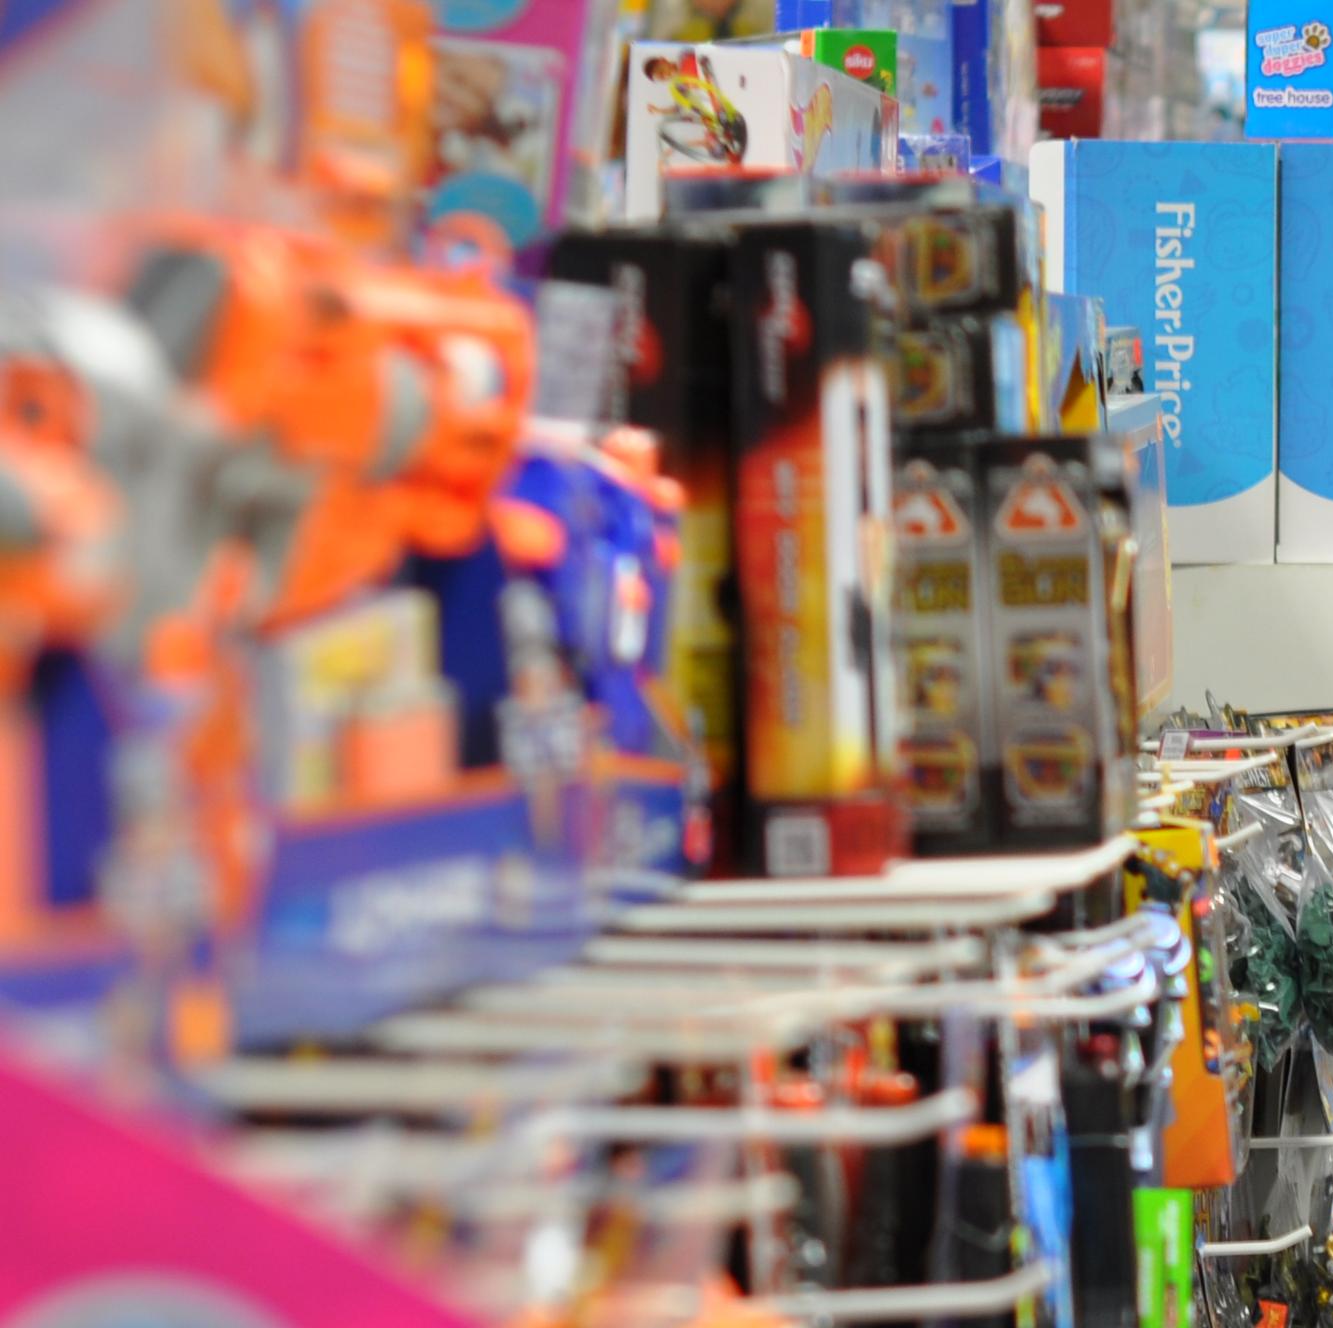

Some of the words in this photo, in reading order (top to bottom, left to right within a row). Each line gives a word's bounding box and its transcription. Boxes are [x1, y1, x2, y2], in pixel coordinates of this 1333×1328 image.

[1263, 51, 1323, 75] doggies
[1256, 90, 1284, 105] tree
[1287, 87, 1330, 105] house
